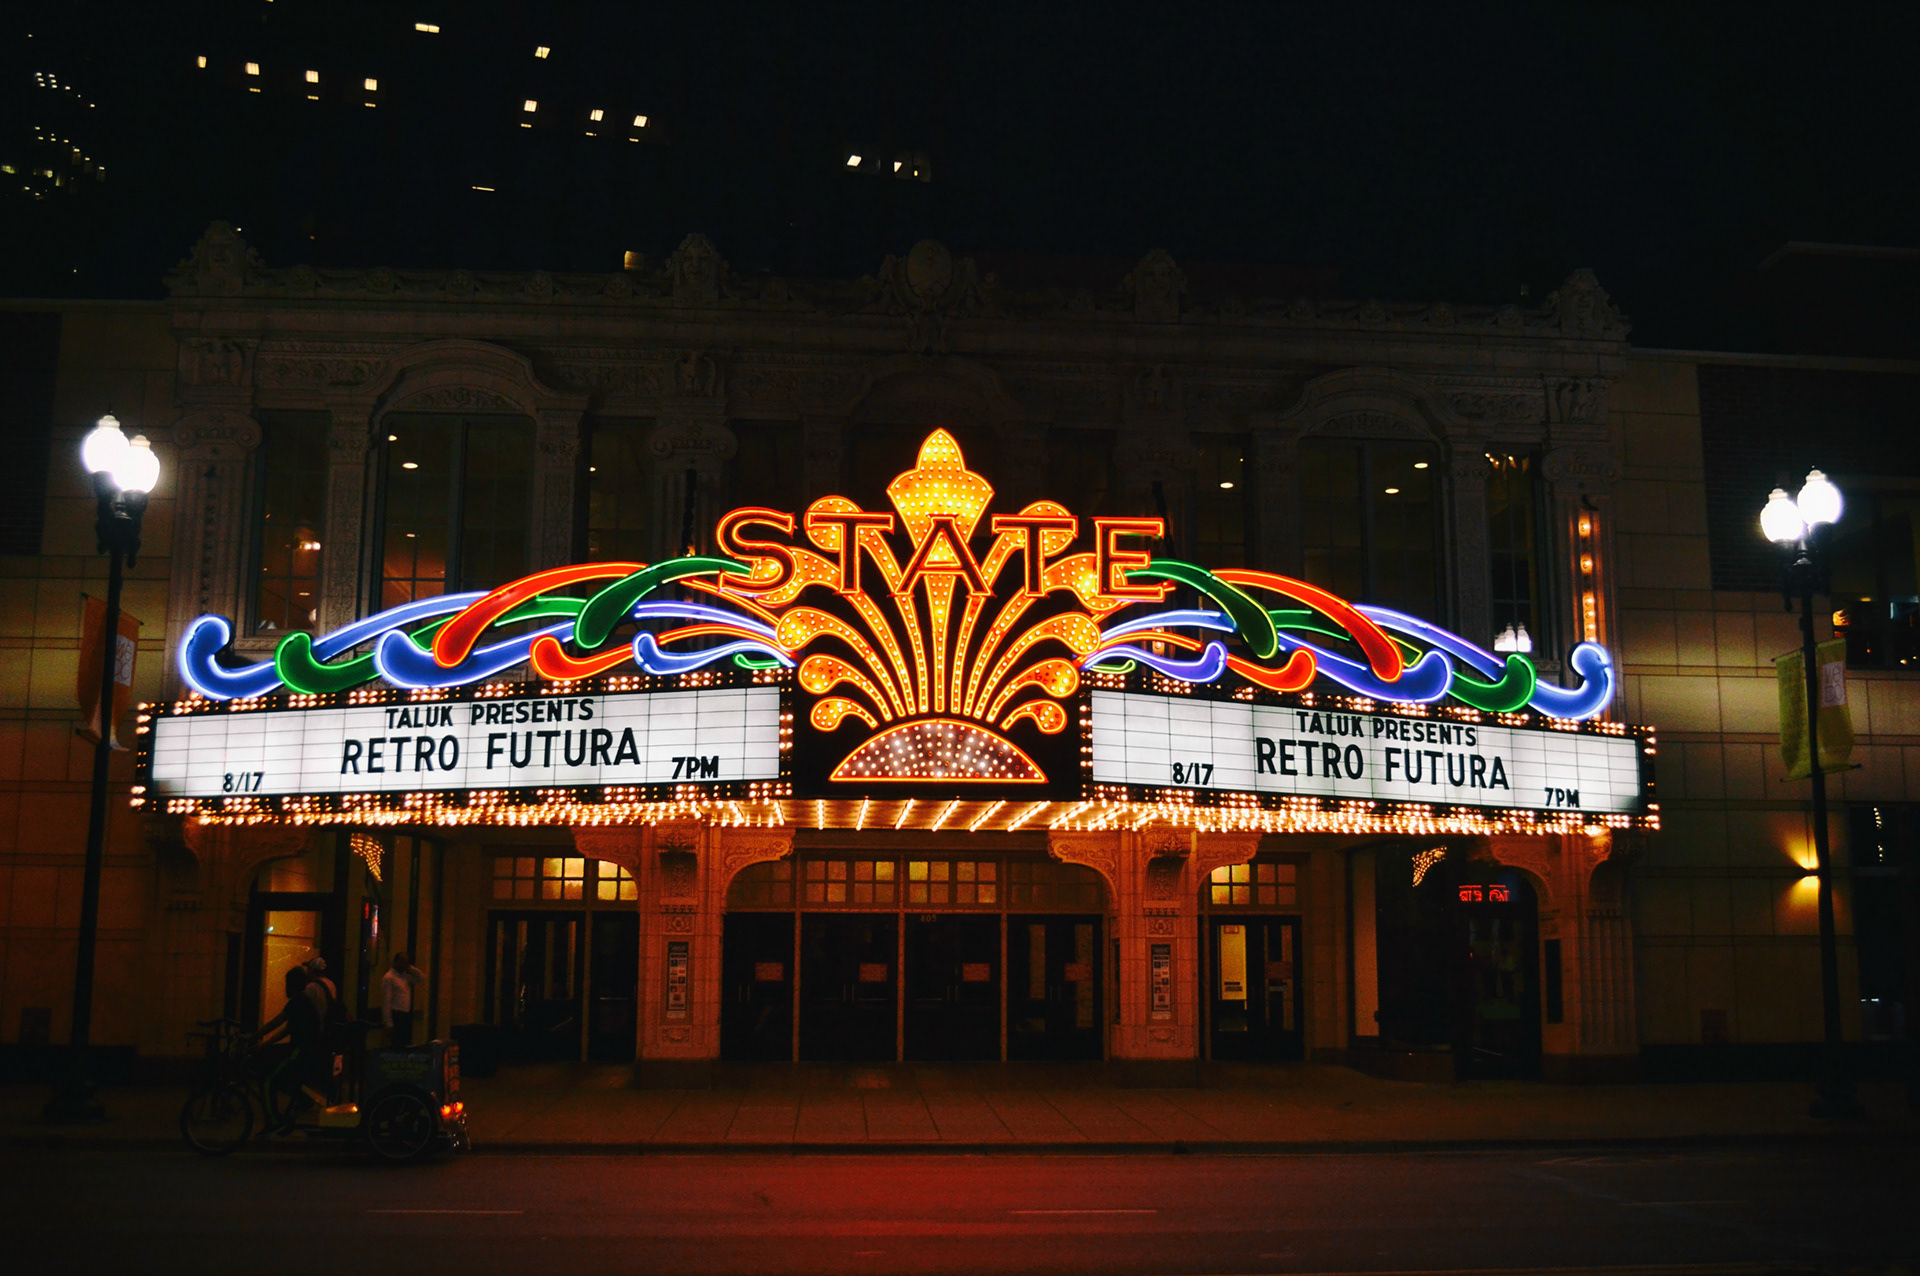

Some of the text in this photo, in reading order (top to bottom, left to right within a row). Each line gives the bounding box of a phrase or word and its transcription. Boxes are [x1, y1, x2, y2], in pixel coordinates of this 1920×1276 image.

[716, 506, 1165, 603] STATE
[385, 698, 594, 729] TALUK PRESENTS
[1296, 711, 1477, 747] TALUK PRESENTS
[340, 727, 641, 775] RETRO FUTURA
[1256, 737, 1509, 790] RETRO FUTURA
[222, 771, 265, 793] 8/17
[672, 755, 719, 779] 7PM
[1172, 762, 1214, 785] 8/17
[1544, 787, 1580, 808] 7PM
